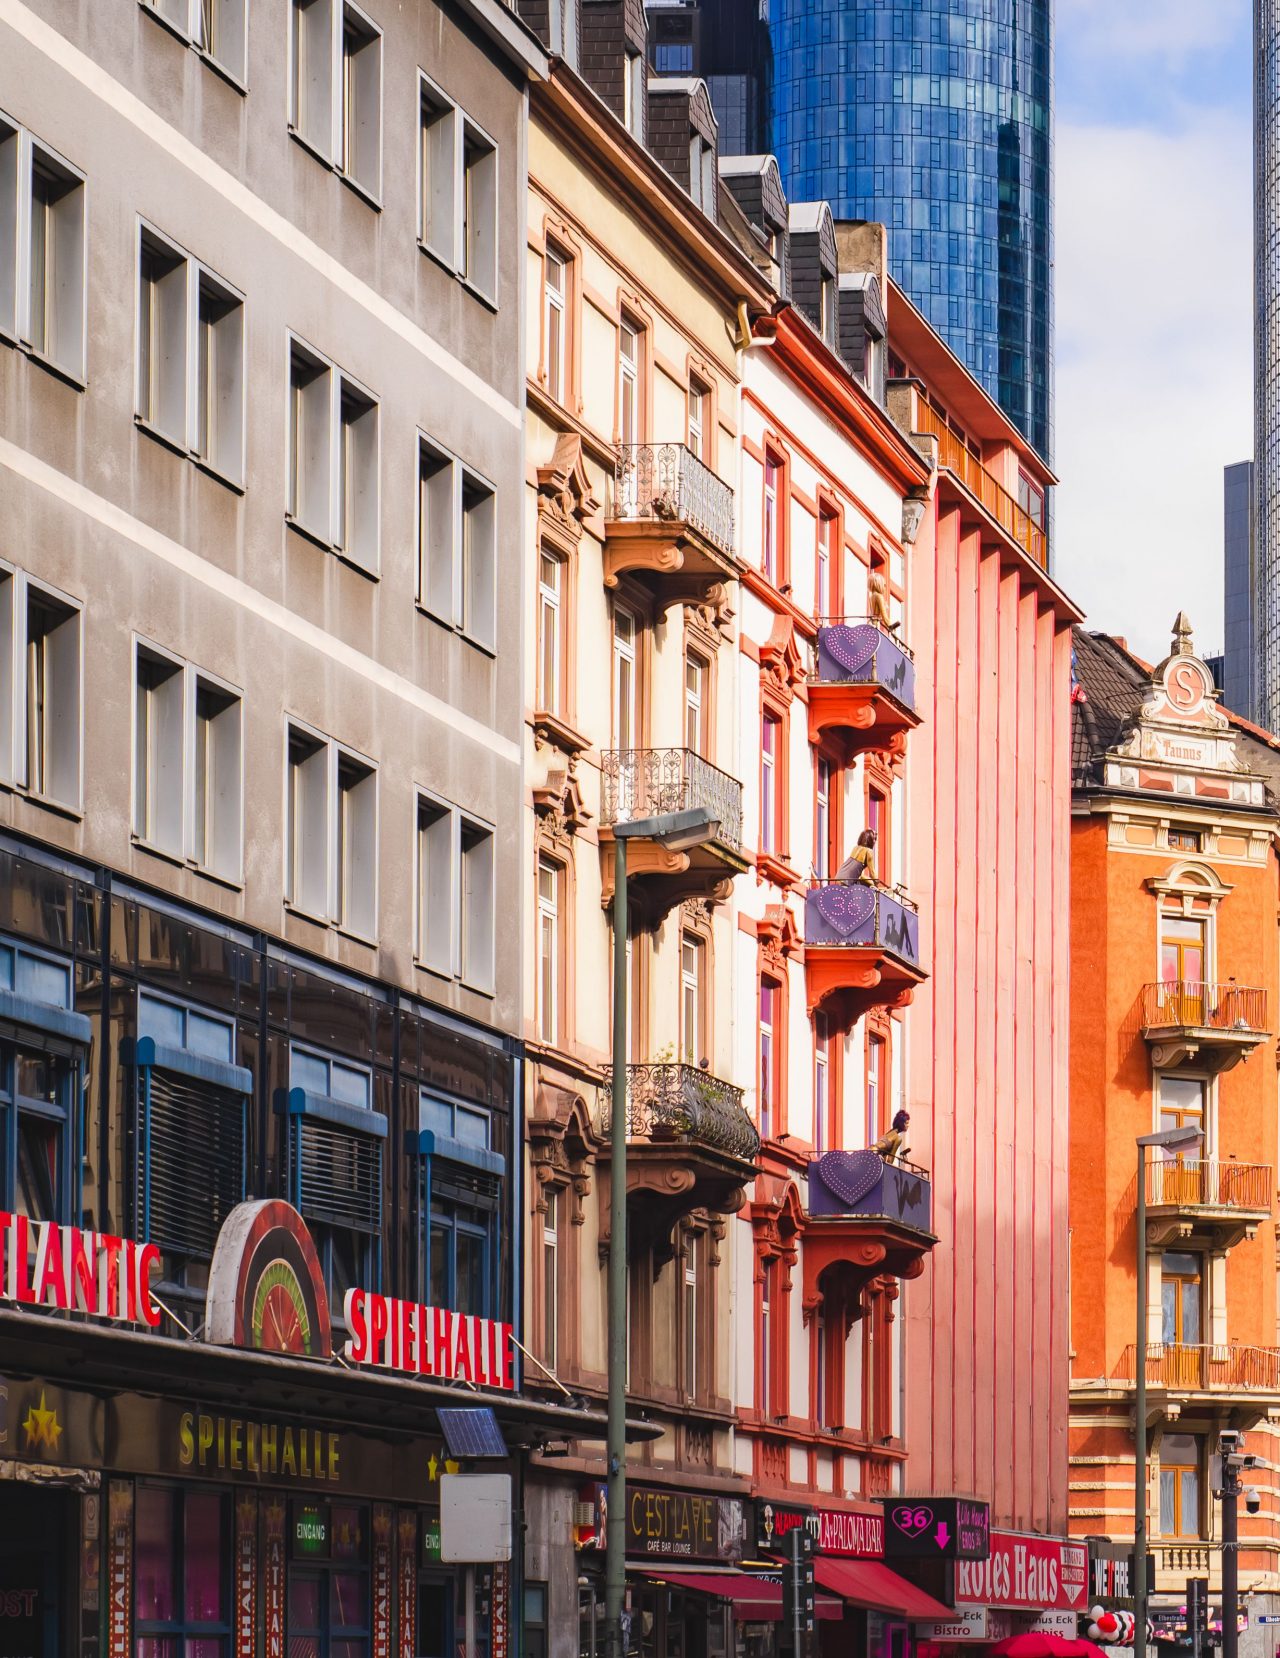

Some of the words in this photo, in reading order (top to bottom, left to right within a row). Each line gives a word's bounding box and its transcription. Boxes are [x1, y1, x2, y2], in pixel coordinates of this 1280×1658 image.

[1174, 668, 1195, 705] S
[1163, 739, 1202, 761] Taunus
[831, 896, 862, 916] 36
[346, 1287, 515, 1390] SPIELHALLE
[178, 1411, 341, 1481] SPIELHALLE
[631, 1491, 670, 1538] C'EST
[674, 1496, 690, 1540] LA
[900, 1510, 927, 1529] 36
[296, 1522, 326, 1541] EINGANG
[425, 1533, 441, 1549] EING
[819, 1512, 832, 1548] LA
[833, 1513, 866, 1554] PALOMA
[866, 1517, 883, 1553] BAR
[647, 1538, 660, 1552] CAFÉ
[661, 1541, 672, 1552] BAR
[672, 1542, 691, 1554] LOUNGE
[958, 1552, 1011, 1600] Rotes
[1013, 1545, 1058, 1603] Haus
[115, 1529, 127, 1658] LHALLE
[963, 1611, 982, 1621] Eck
[1019, 1615, 1053, 1624] Taunus
[1056, 1615, 1073, 1624] Eck
[1158, 1614, 1186, 1622] Elbestraße
[934, 1624, 971, 1636] Bistro
